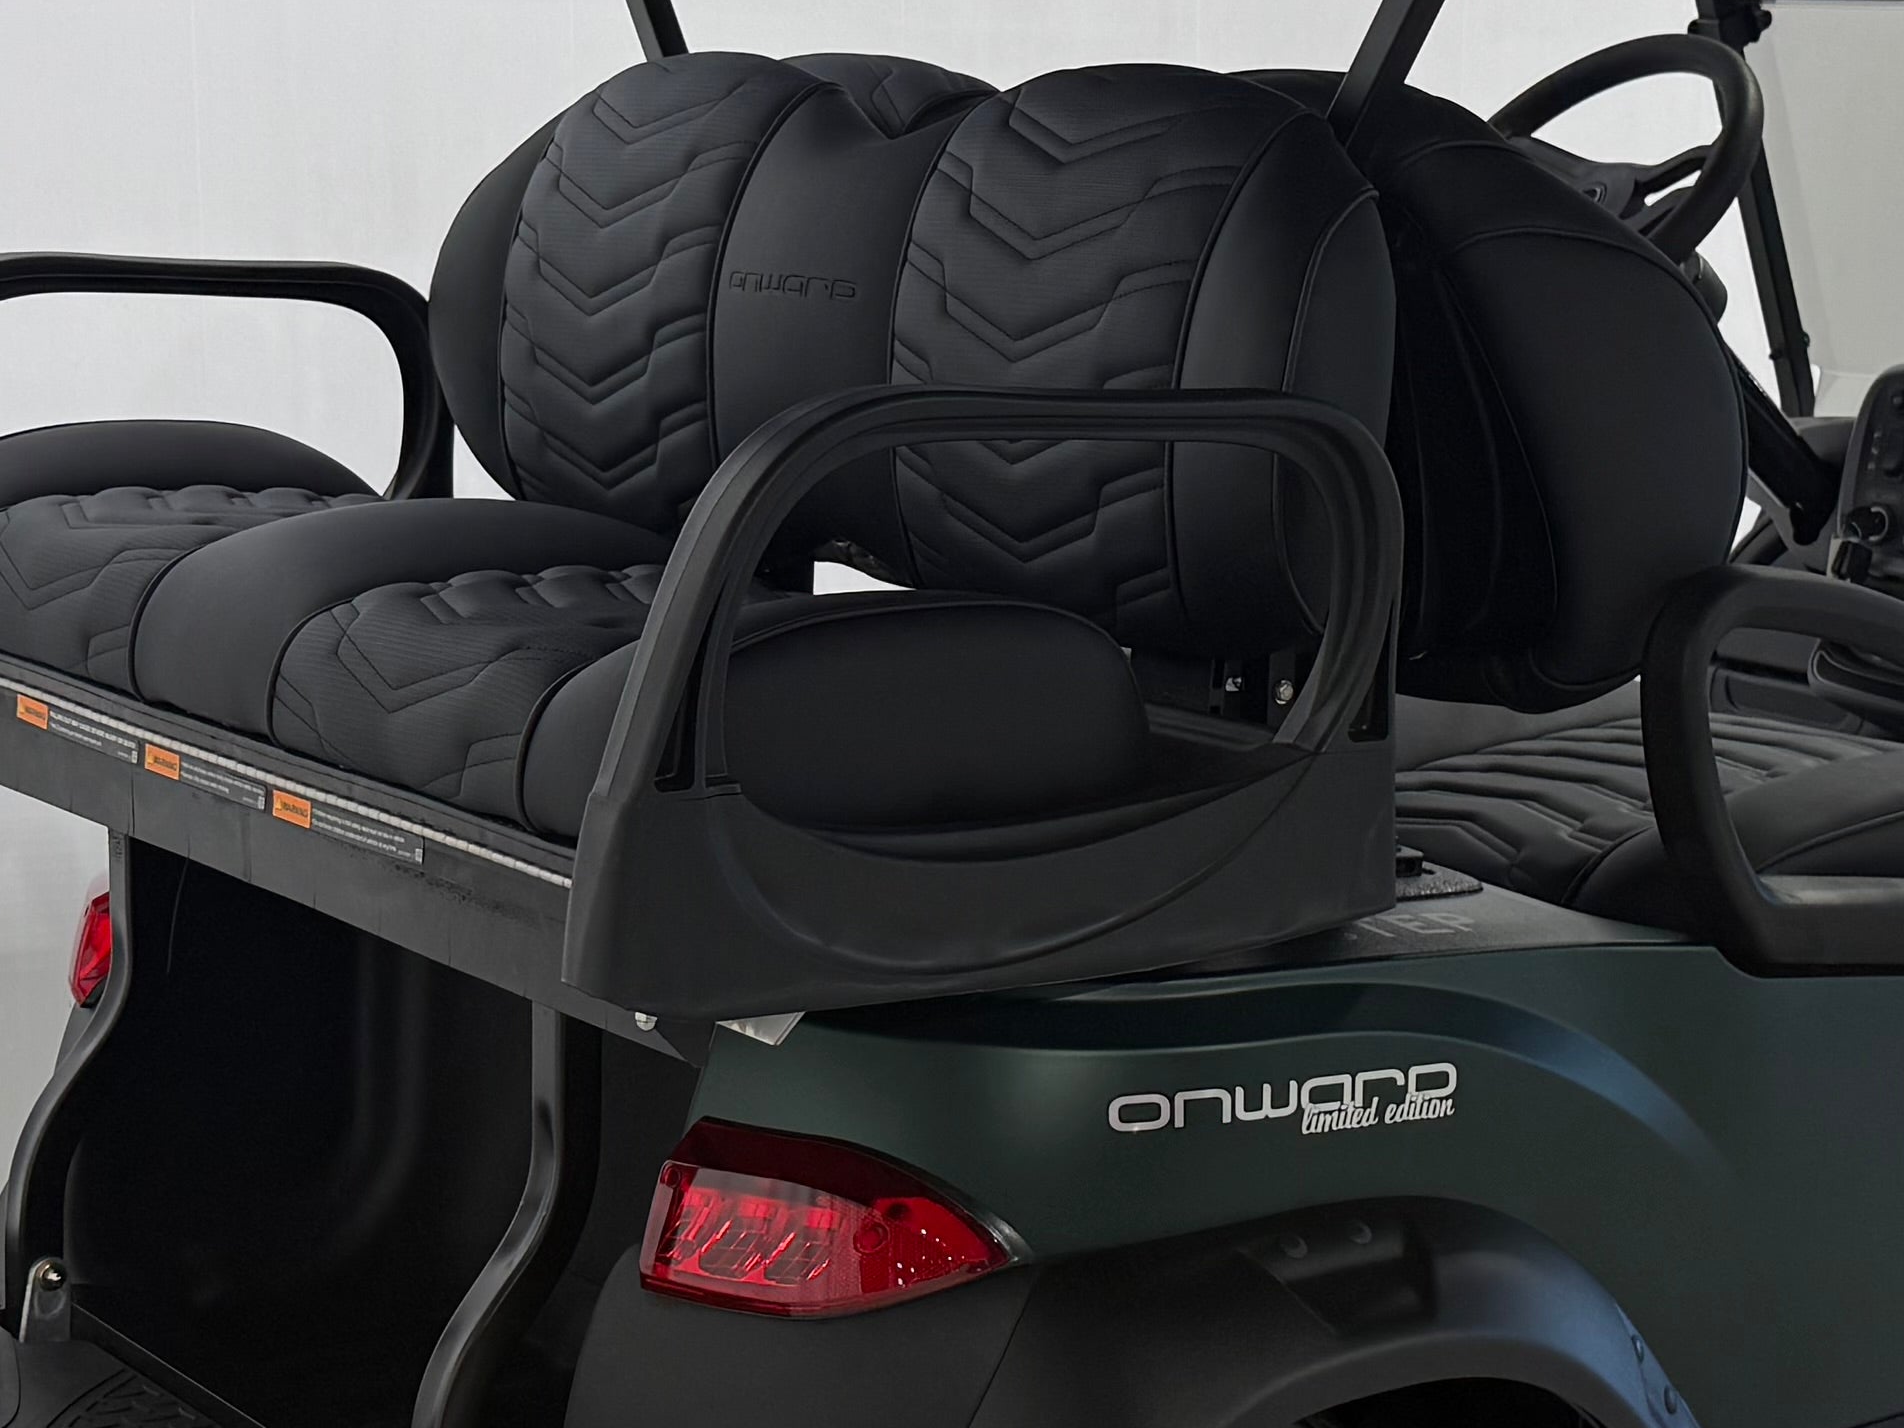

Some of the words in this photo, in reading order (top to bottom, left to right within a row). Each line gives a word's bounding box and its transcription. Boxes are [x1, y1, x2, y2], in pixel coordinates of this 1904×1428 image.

[1343, 912, 1475, 940] TEP
[1301, 1096, 1379, 1135] limited
[1384, 1092, 1456, 1124] edition
